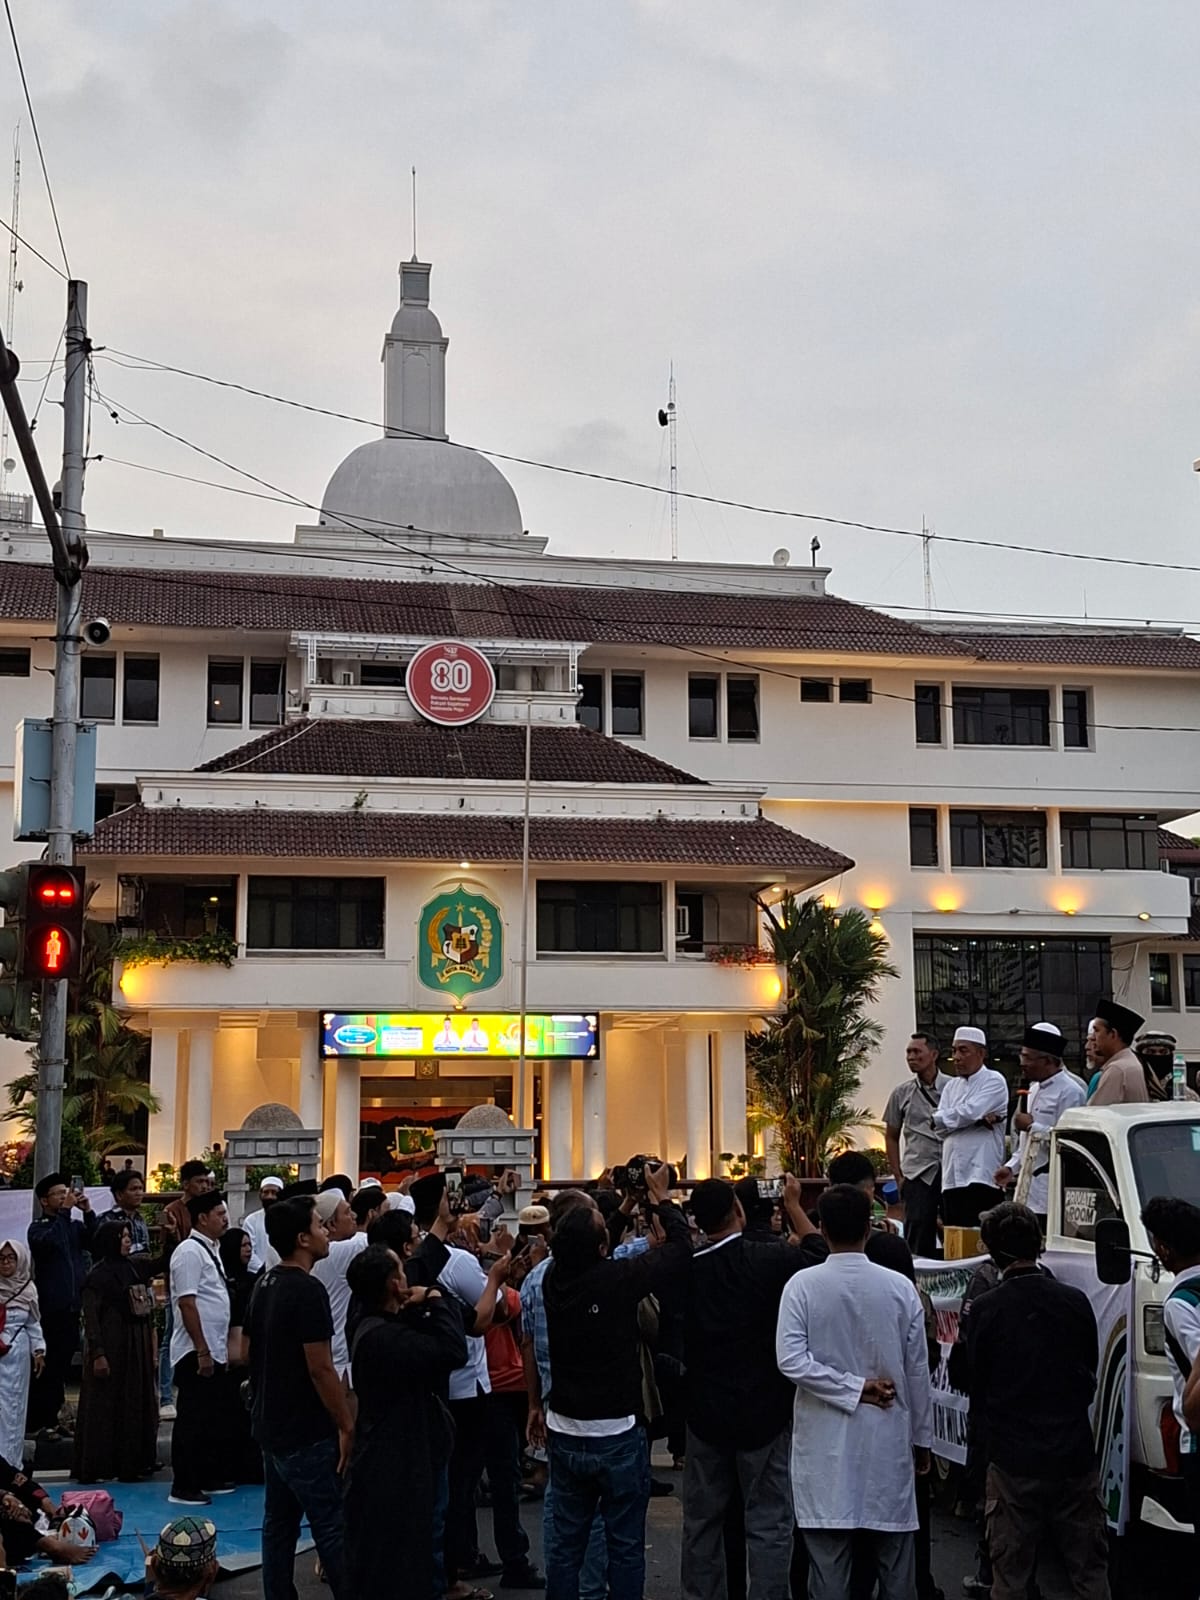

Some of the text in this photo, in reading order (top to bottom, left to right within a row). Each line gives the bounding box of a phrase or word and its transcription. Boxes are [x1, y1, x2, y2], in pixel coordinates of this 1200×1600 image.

[430, 658, 472, 693] 80
[1065, 1190, 1097, 1206] PRIVATE
[1069, 1206, 1093, 1223] ROOM
